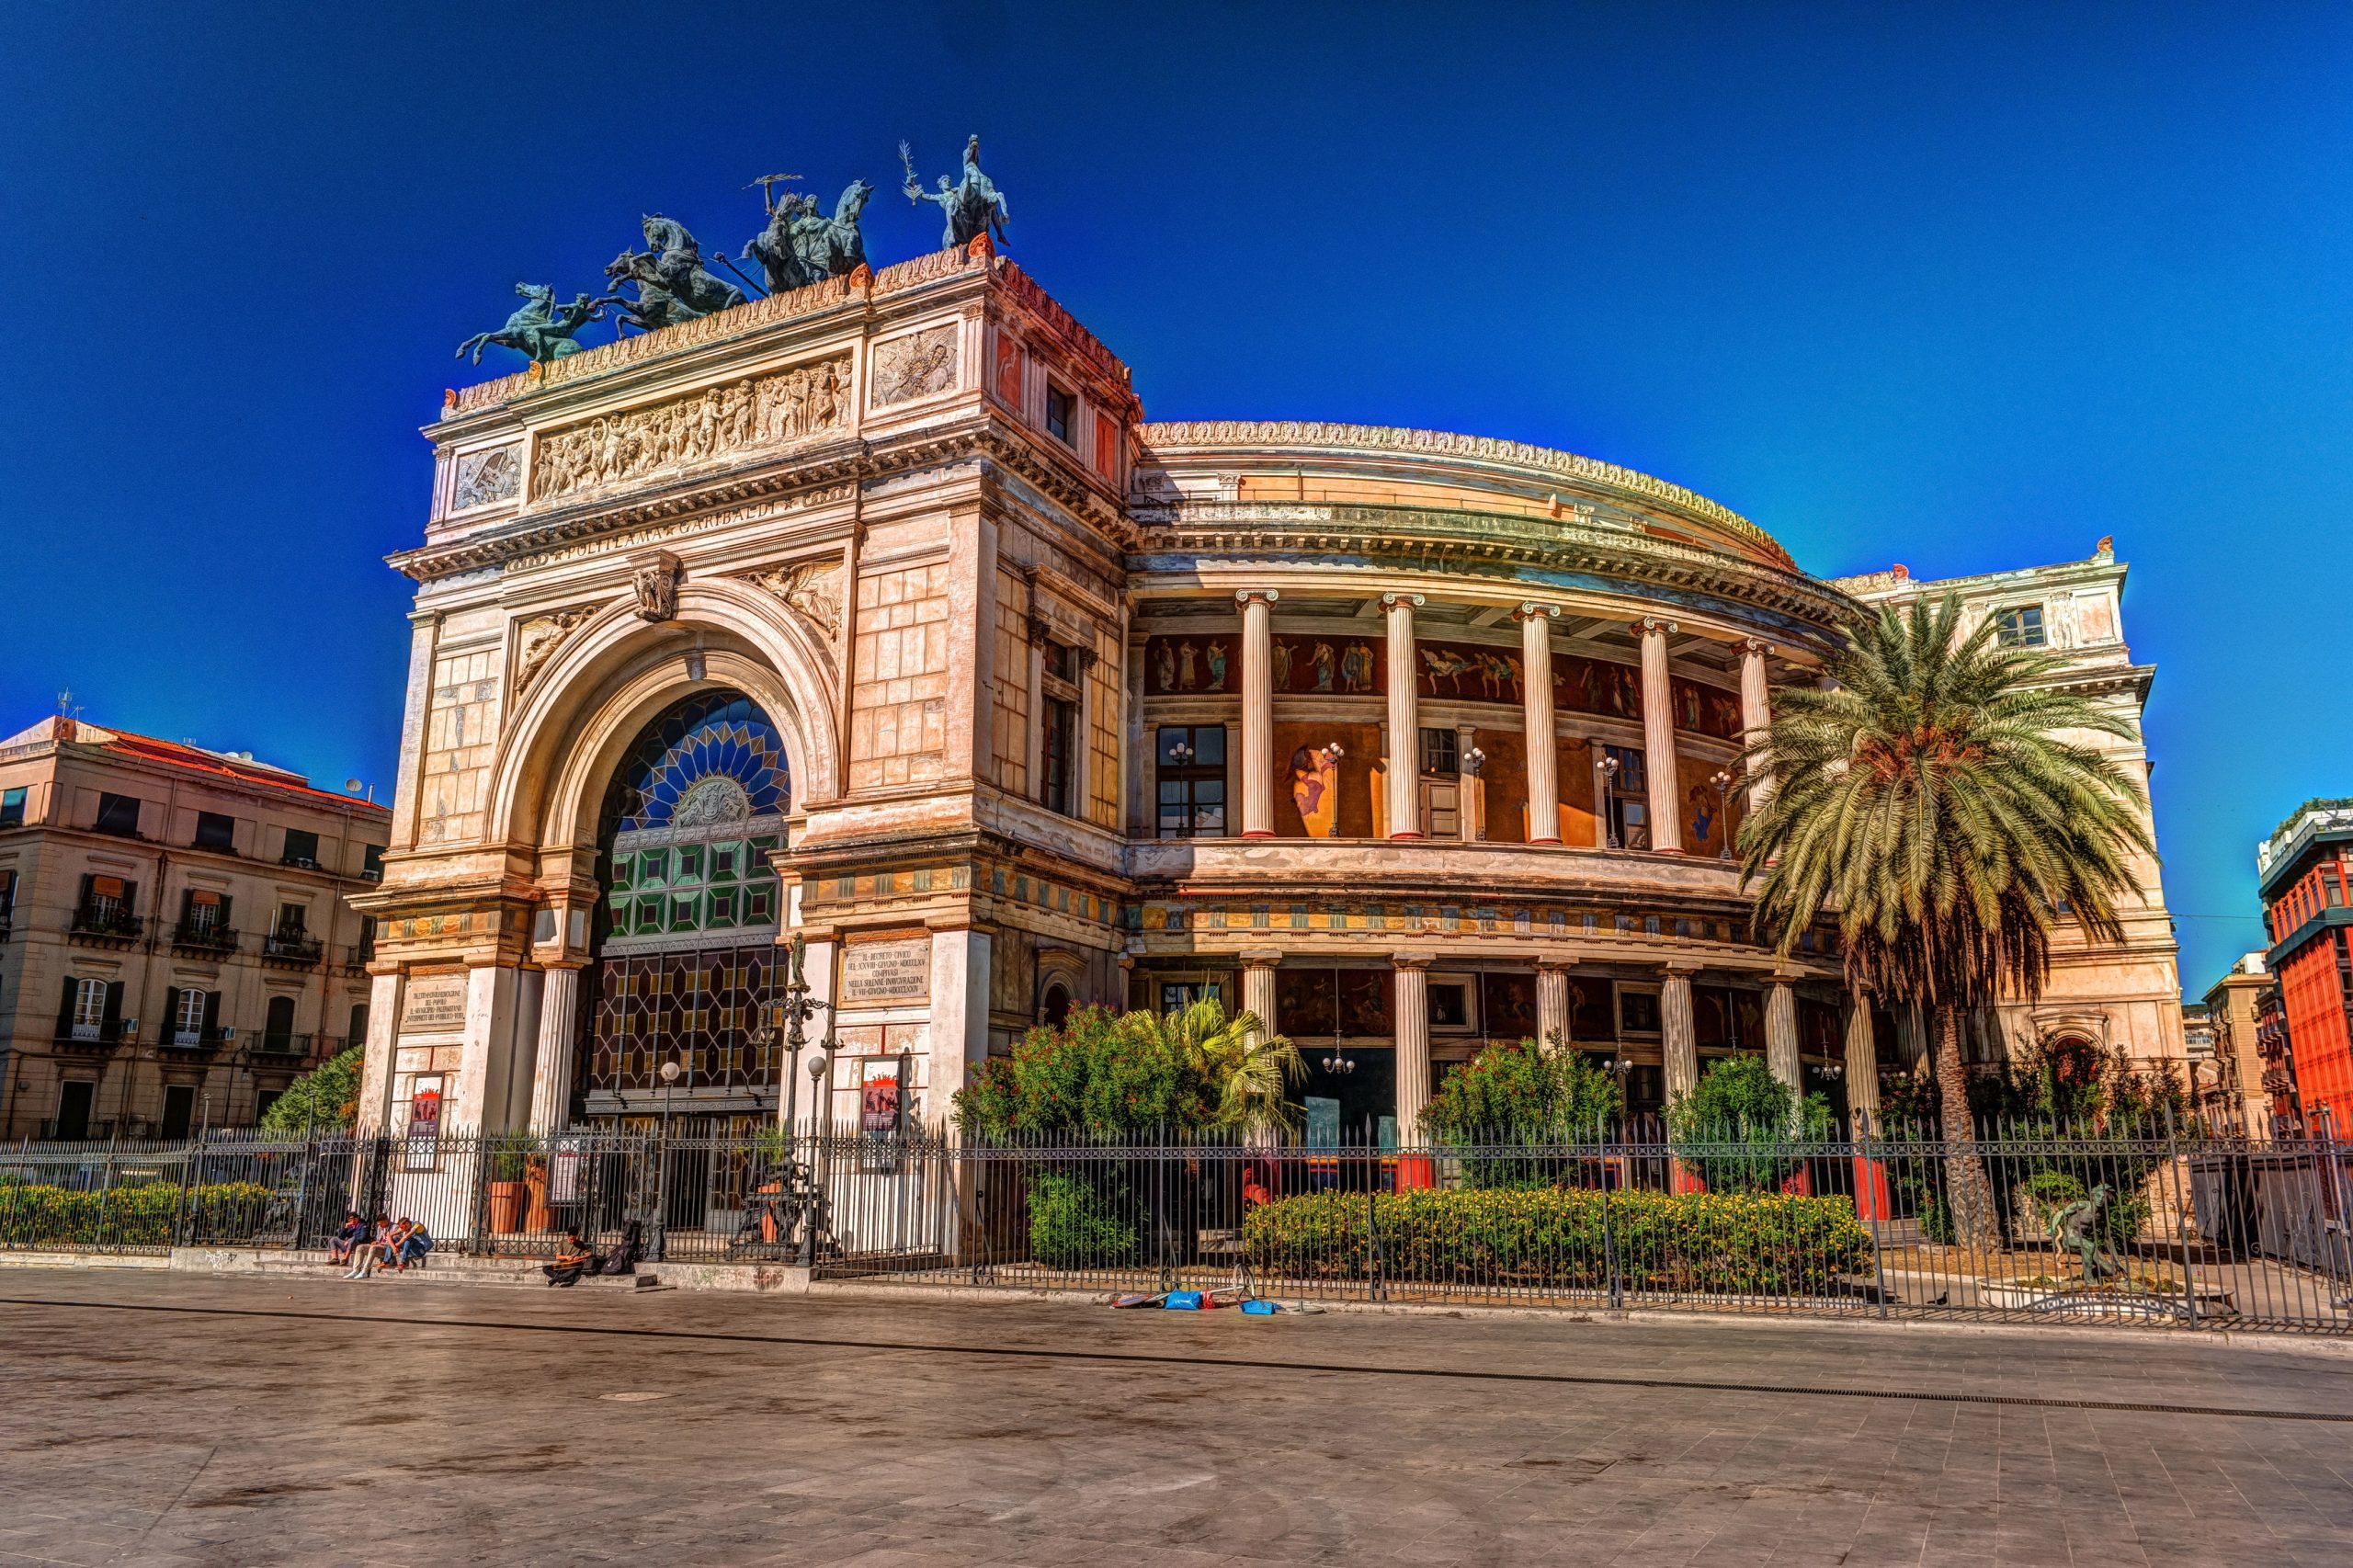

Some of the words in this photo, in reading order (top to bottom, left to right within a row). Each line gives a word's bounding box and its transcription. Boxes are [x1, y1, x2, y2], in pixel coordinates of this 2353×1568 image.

[567, 527, 663, 559] POLITEAMA
[678, 499, 775, 534] GARIBALDI
[862, 952, 869, 960] IL
[870, 951, 892, 960] DECRETO
[893, 950, 912, 959] CIVICO
[848, 979, 863, 988] NELLA
[863, 978, 884, 986] SOLENNE
